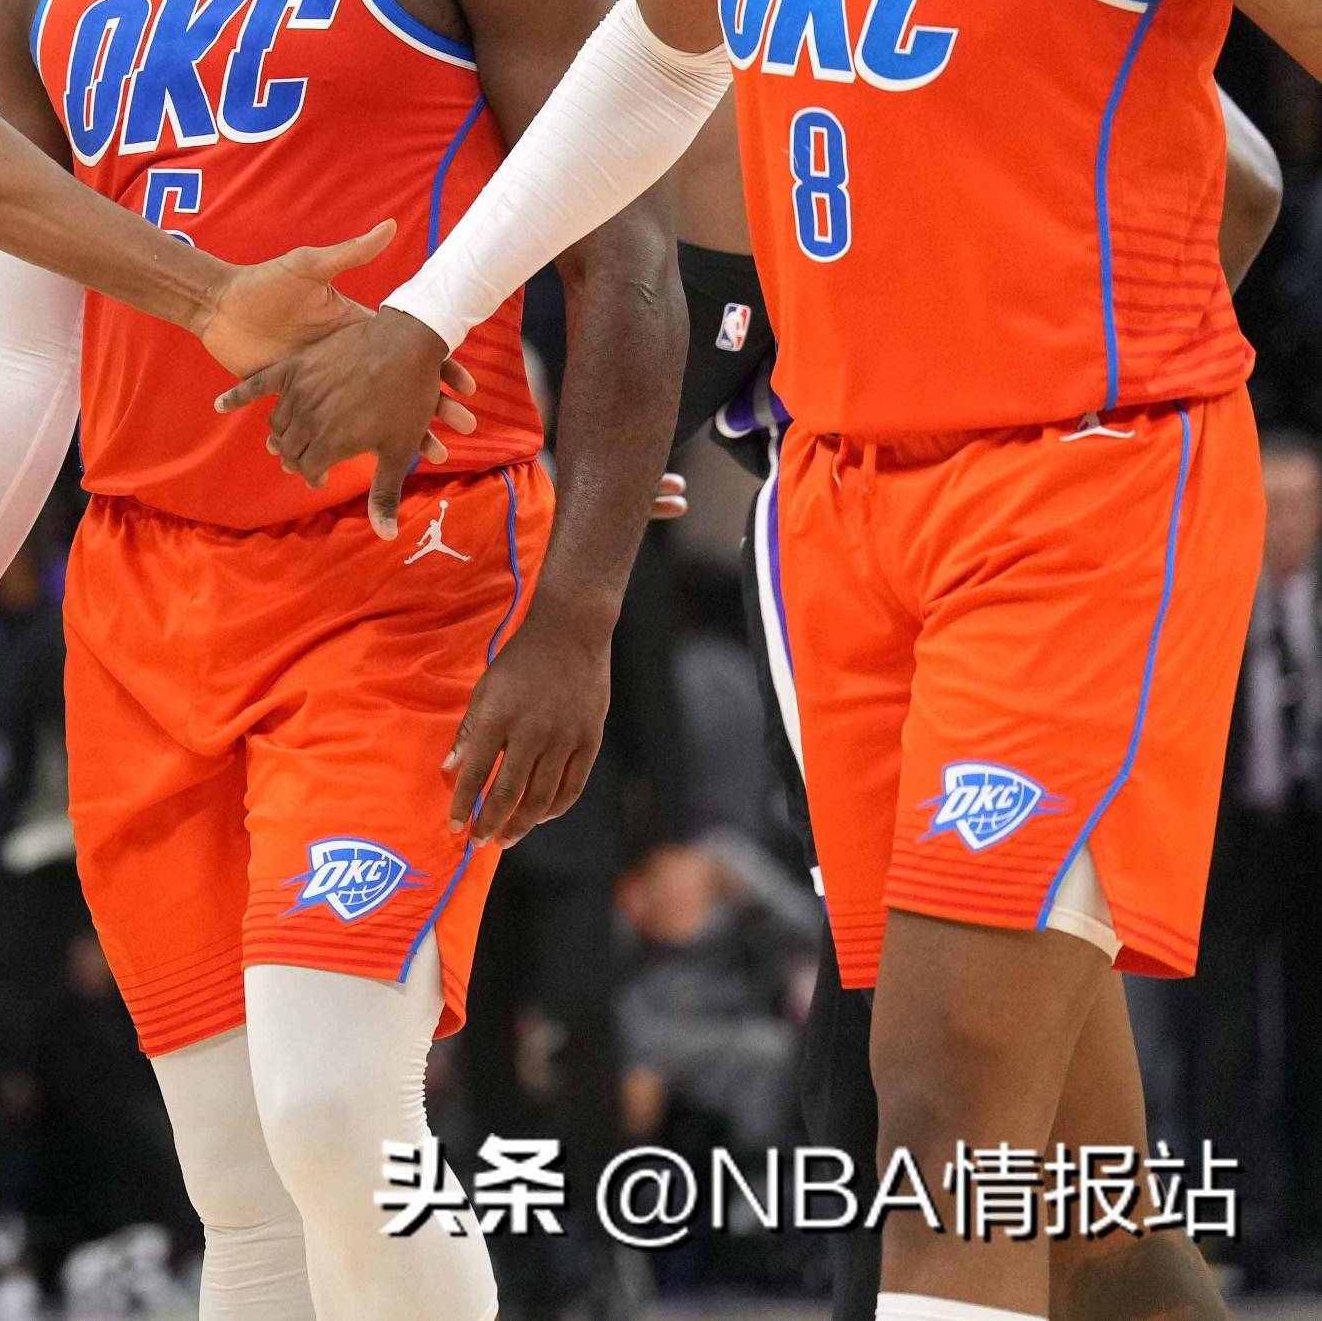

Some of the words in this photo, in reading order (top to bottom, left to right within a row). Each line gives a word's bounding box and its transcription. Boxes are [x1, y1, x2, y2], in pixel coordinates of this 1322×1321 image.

[789, 106, 852, 264] 8
[934, 784, 1020, 826] OKC
[301, 859, 388, 899] OKC
